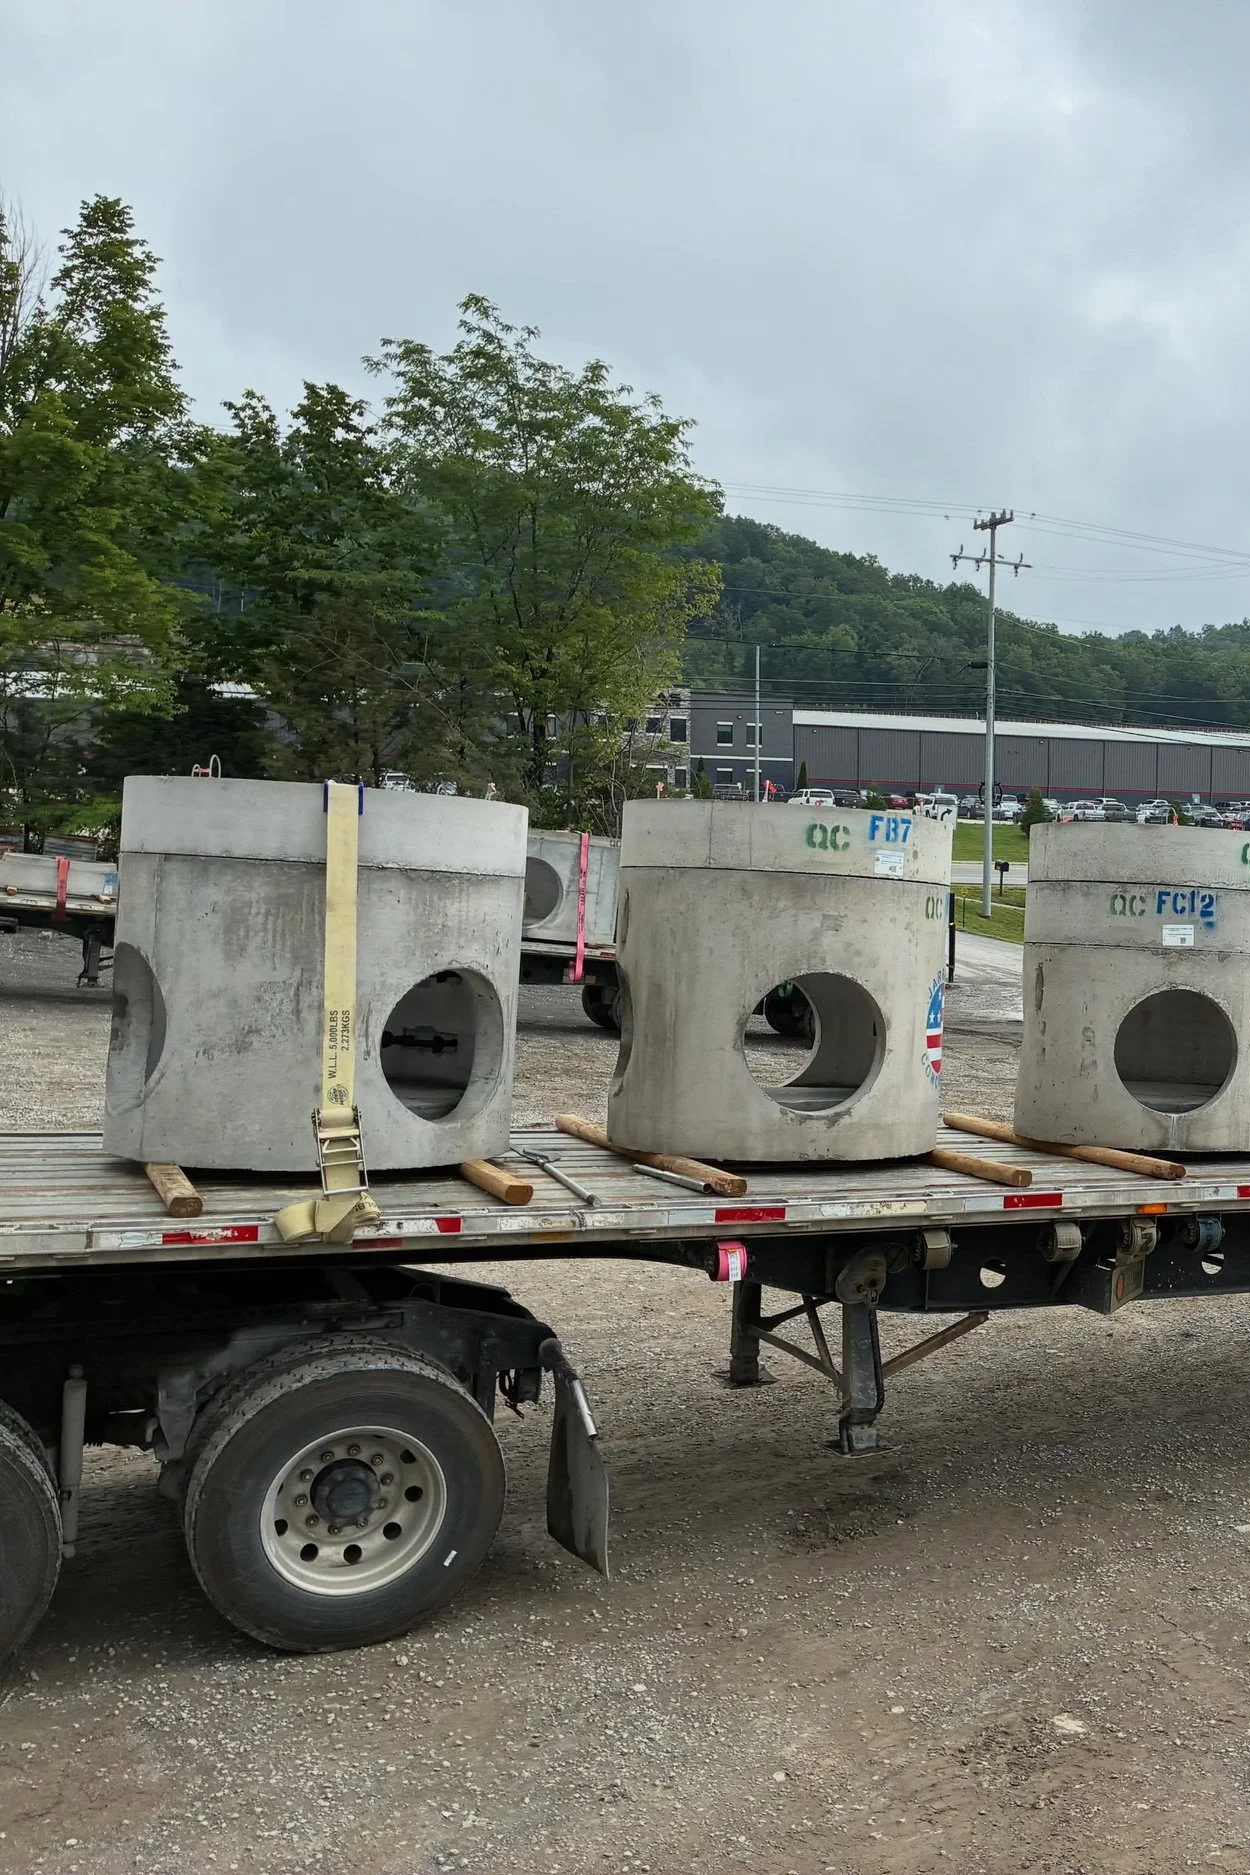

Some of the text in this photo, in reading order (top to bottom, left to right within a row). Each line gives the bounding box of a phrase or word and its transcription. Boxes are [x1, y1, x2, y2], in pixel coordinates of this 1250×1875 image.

[806, 823, 850, 850] QC
[868, 815, 912, 843] FB7
[925, 896, 943, 920] QC
[1110, 890, 1214, 917] QC FC12
[329, 1010, 338, 1050] 5,000LBS
